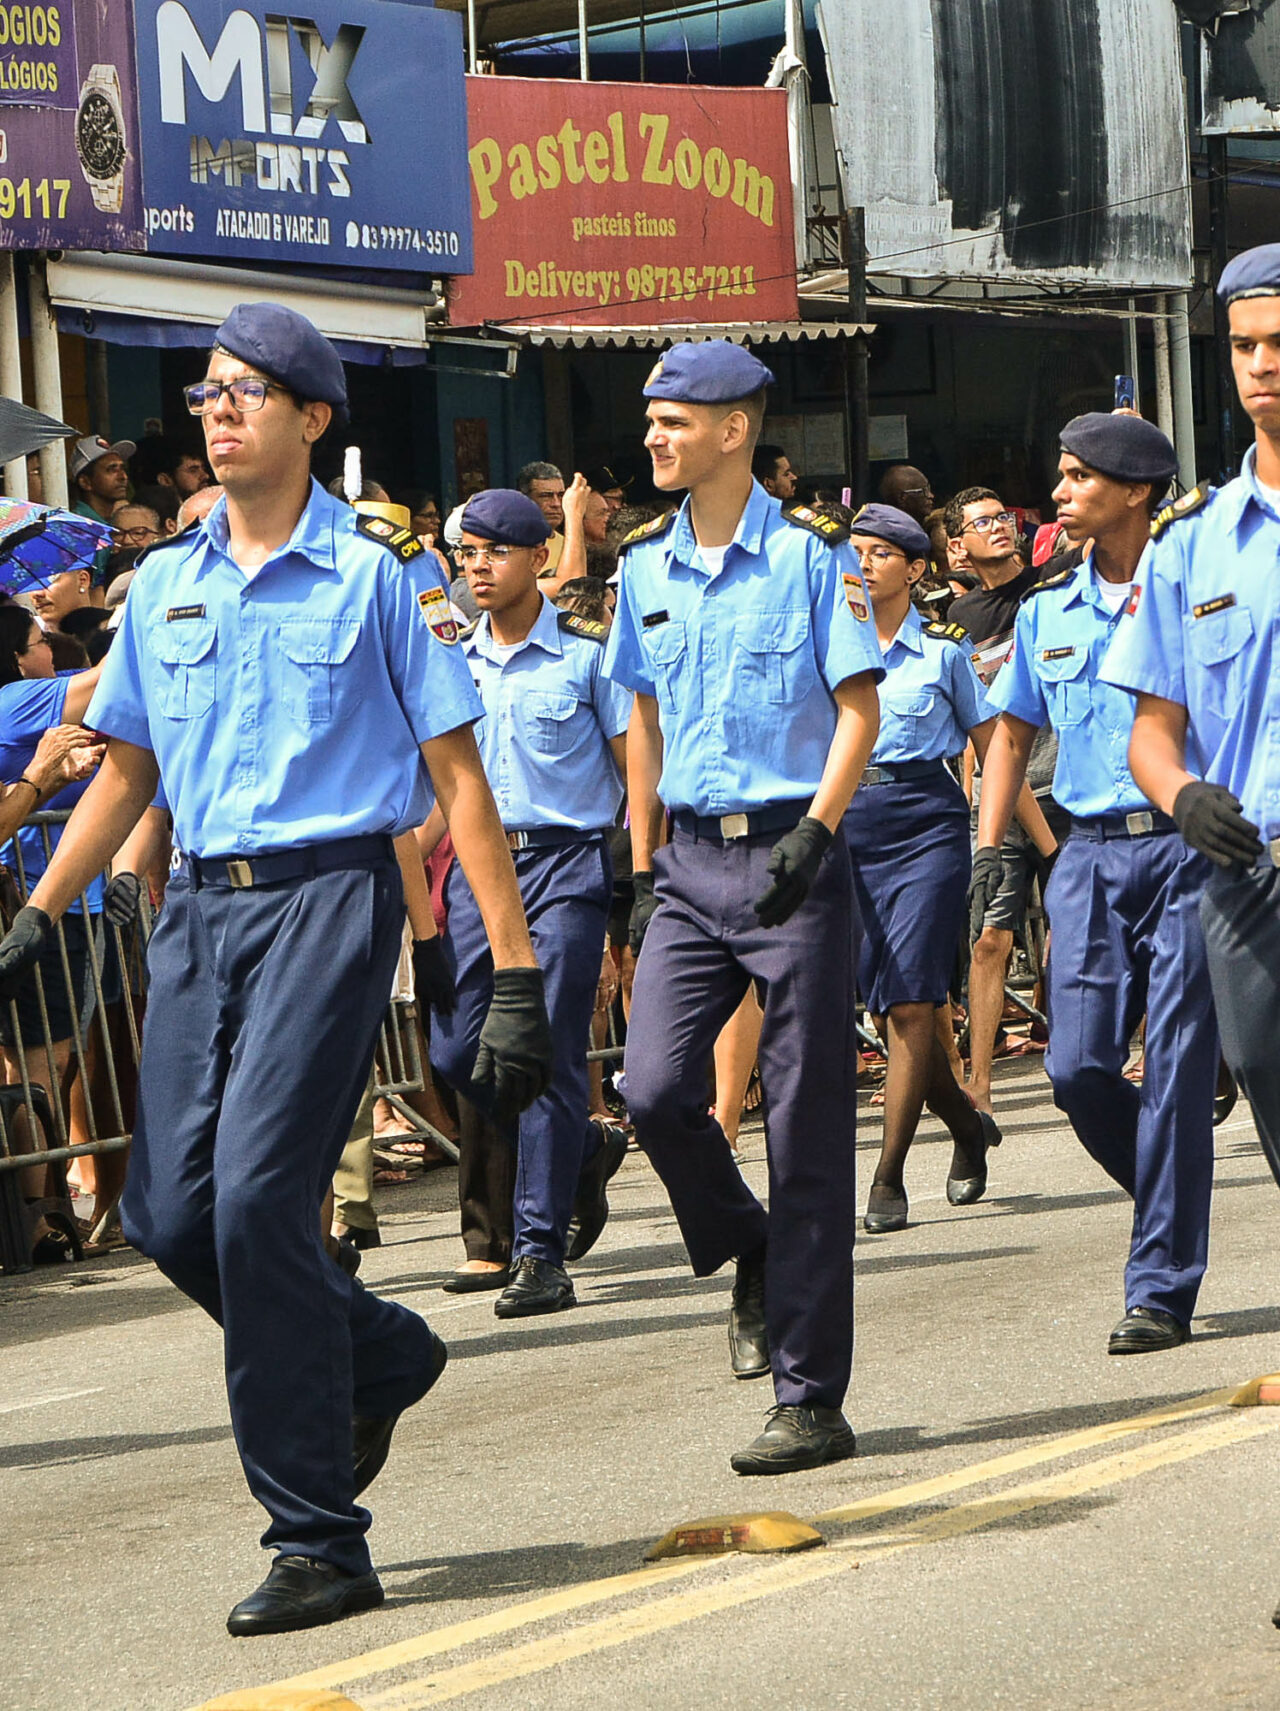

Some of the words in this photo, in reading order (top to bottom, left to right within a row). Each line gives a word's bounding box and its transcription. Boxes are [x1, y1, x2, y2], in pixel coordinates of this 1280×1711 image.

[189, 135, 350, 197] IMPORTS
[468, 111, 629, 220] Pastel
[639, 112, 775, 226] Zoom
[0, 178, 71, 219] 9117
[215, 209, 270, 241] ATACADO
[273, 216, 282, 242] &
[284, 215, 330, 246] VAREJO
[572, 211, 631, 241] pasteis
[634, 212, 676, 237] finos
[504, 260, 621, 305] Delivery:
[626, 264, 757, 302] 98735-7211
